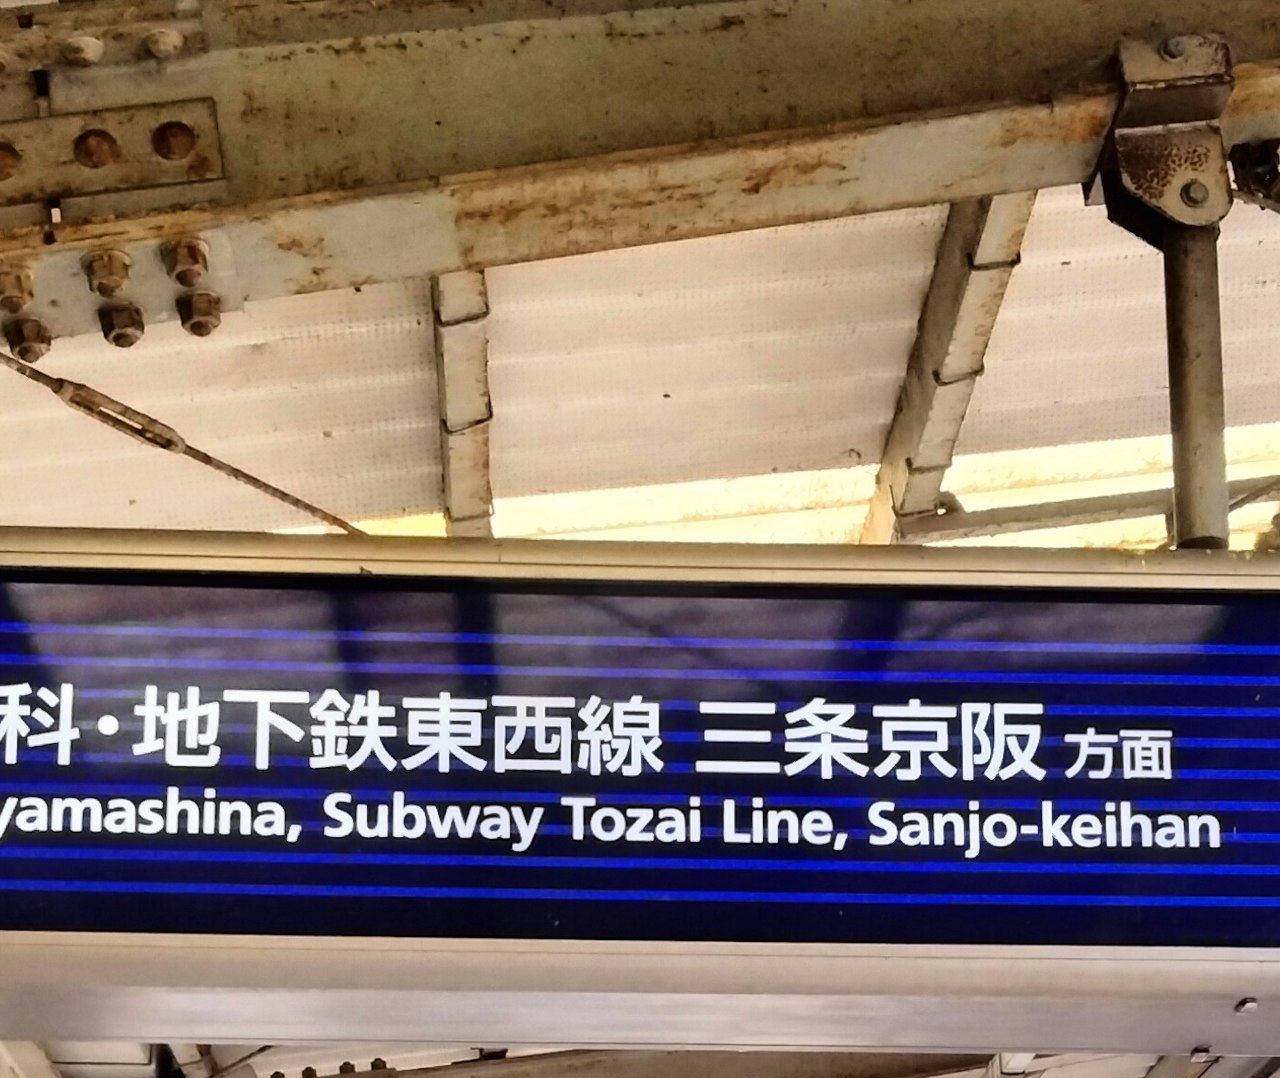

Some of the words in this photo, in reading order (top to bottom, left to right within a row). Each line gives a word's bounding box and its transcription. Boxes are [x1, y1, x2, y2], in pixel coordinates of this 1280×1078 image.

[695, 697, 1044, 781] 三条京阪
[1064, 727, 1174, 780] 方面
[323, 791, 544, 852] Subway
[560, 796, 701, 843] Tozai
[723, 797, 848, 851] Line,
[868, 800, 1221, 859] Sanjo-keihan
